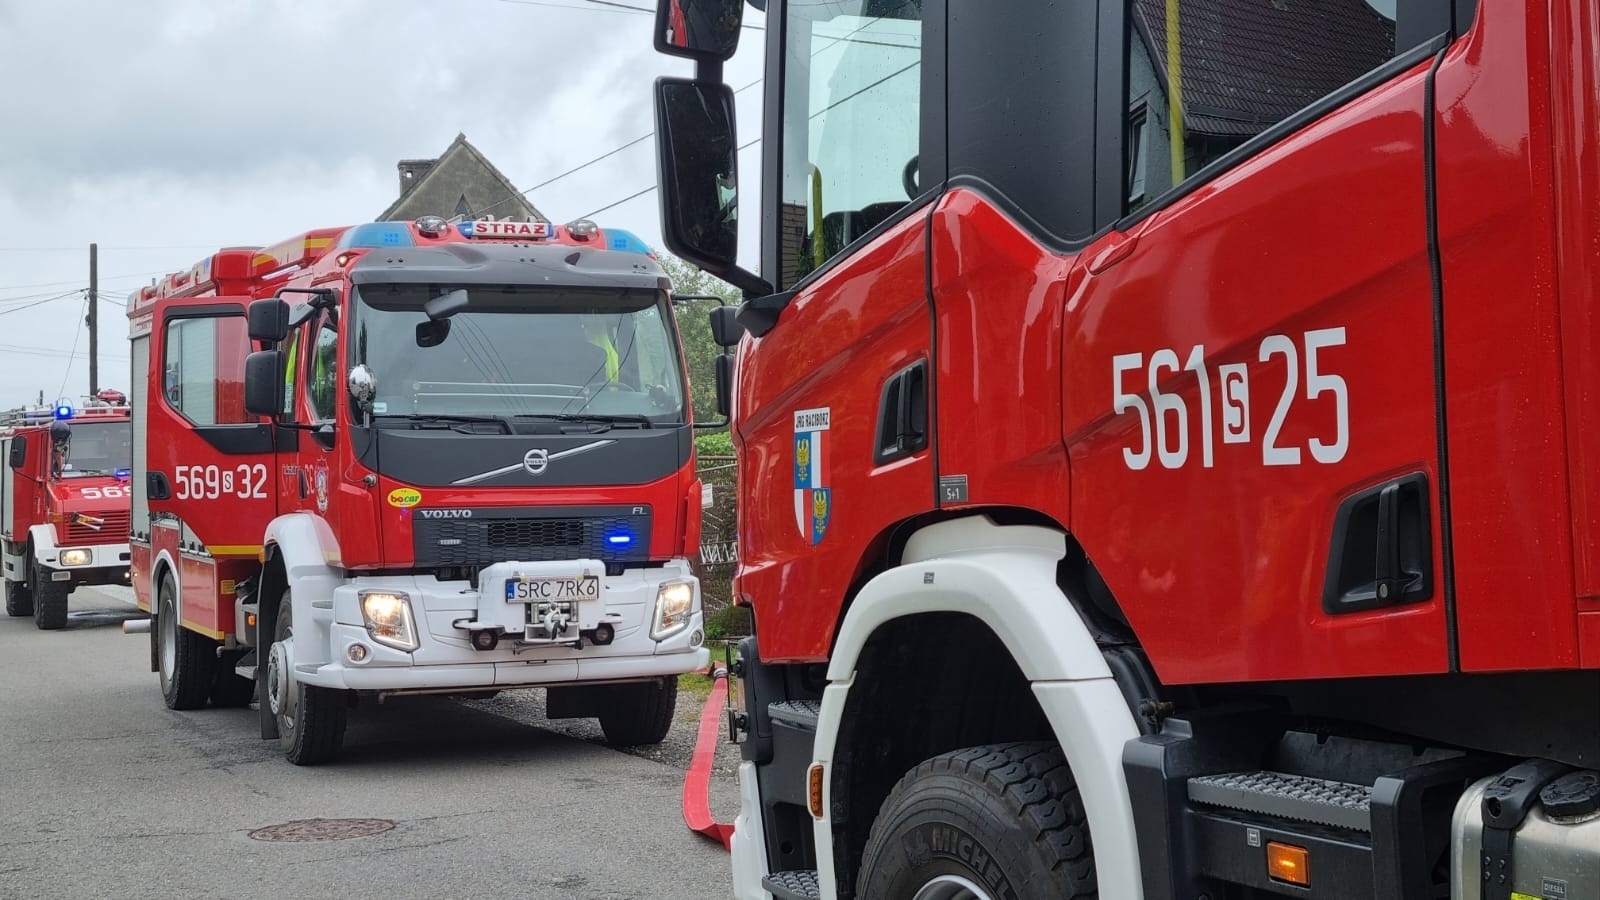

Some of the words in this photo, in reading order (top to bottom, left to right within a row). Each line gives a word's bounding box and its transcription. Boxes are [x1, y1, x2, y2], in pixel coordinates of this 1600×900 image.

[1112, 344, 1213, 470] 561
[1258, 326, 1349, 465] 25
[175, 464, 220, 500] 569
[236, 463, 267, 499] 32
[420, 509, 472, 518] VOLVO
[632, 506, 649, 515] FL
[517, 582, 551, 599] SRC
[556, 579, 596, 597] 7RK6
[1544, 883, 1565, 894] DIESEL
